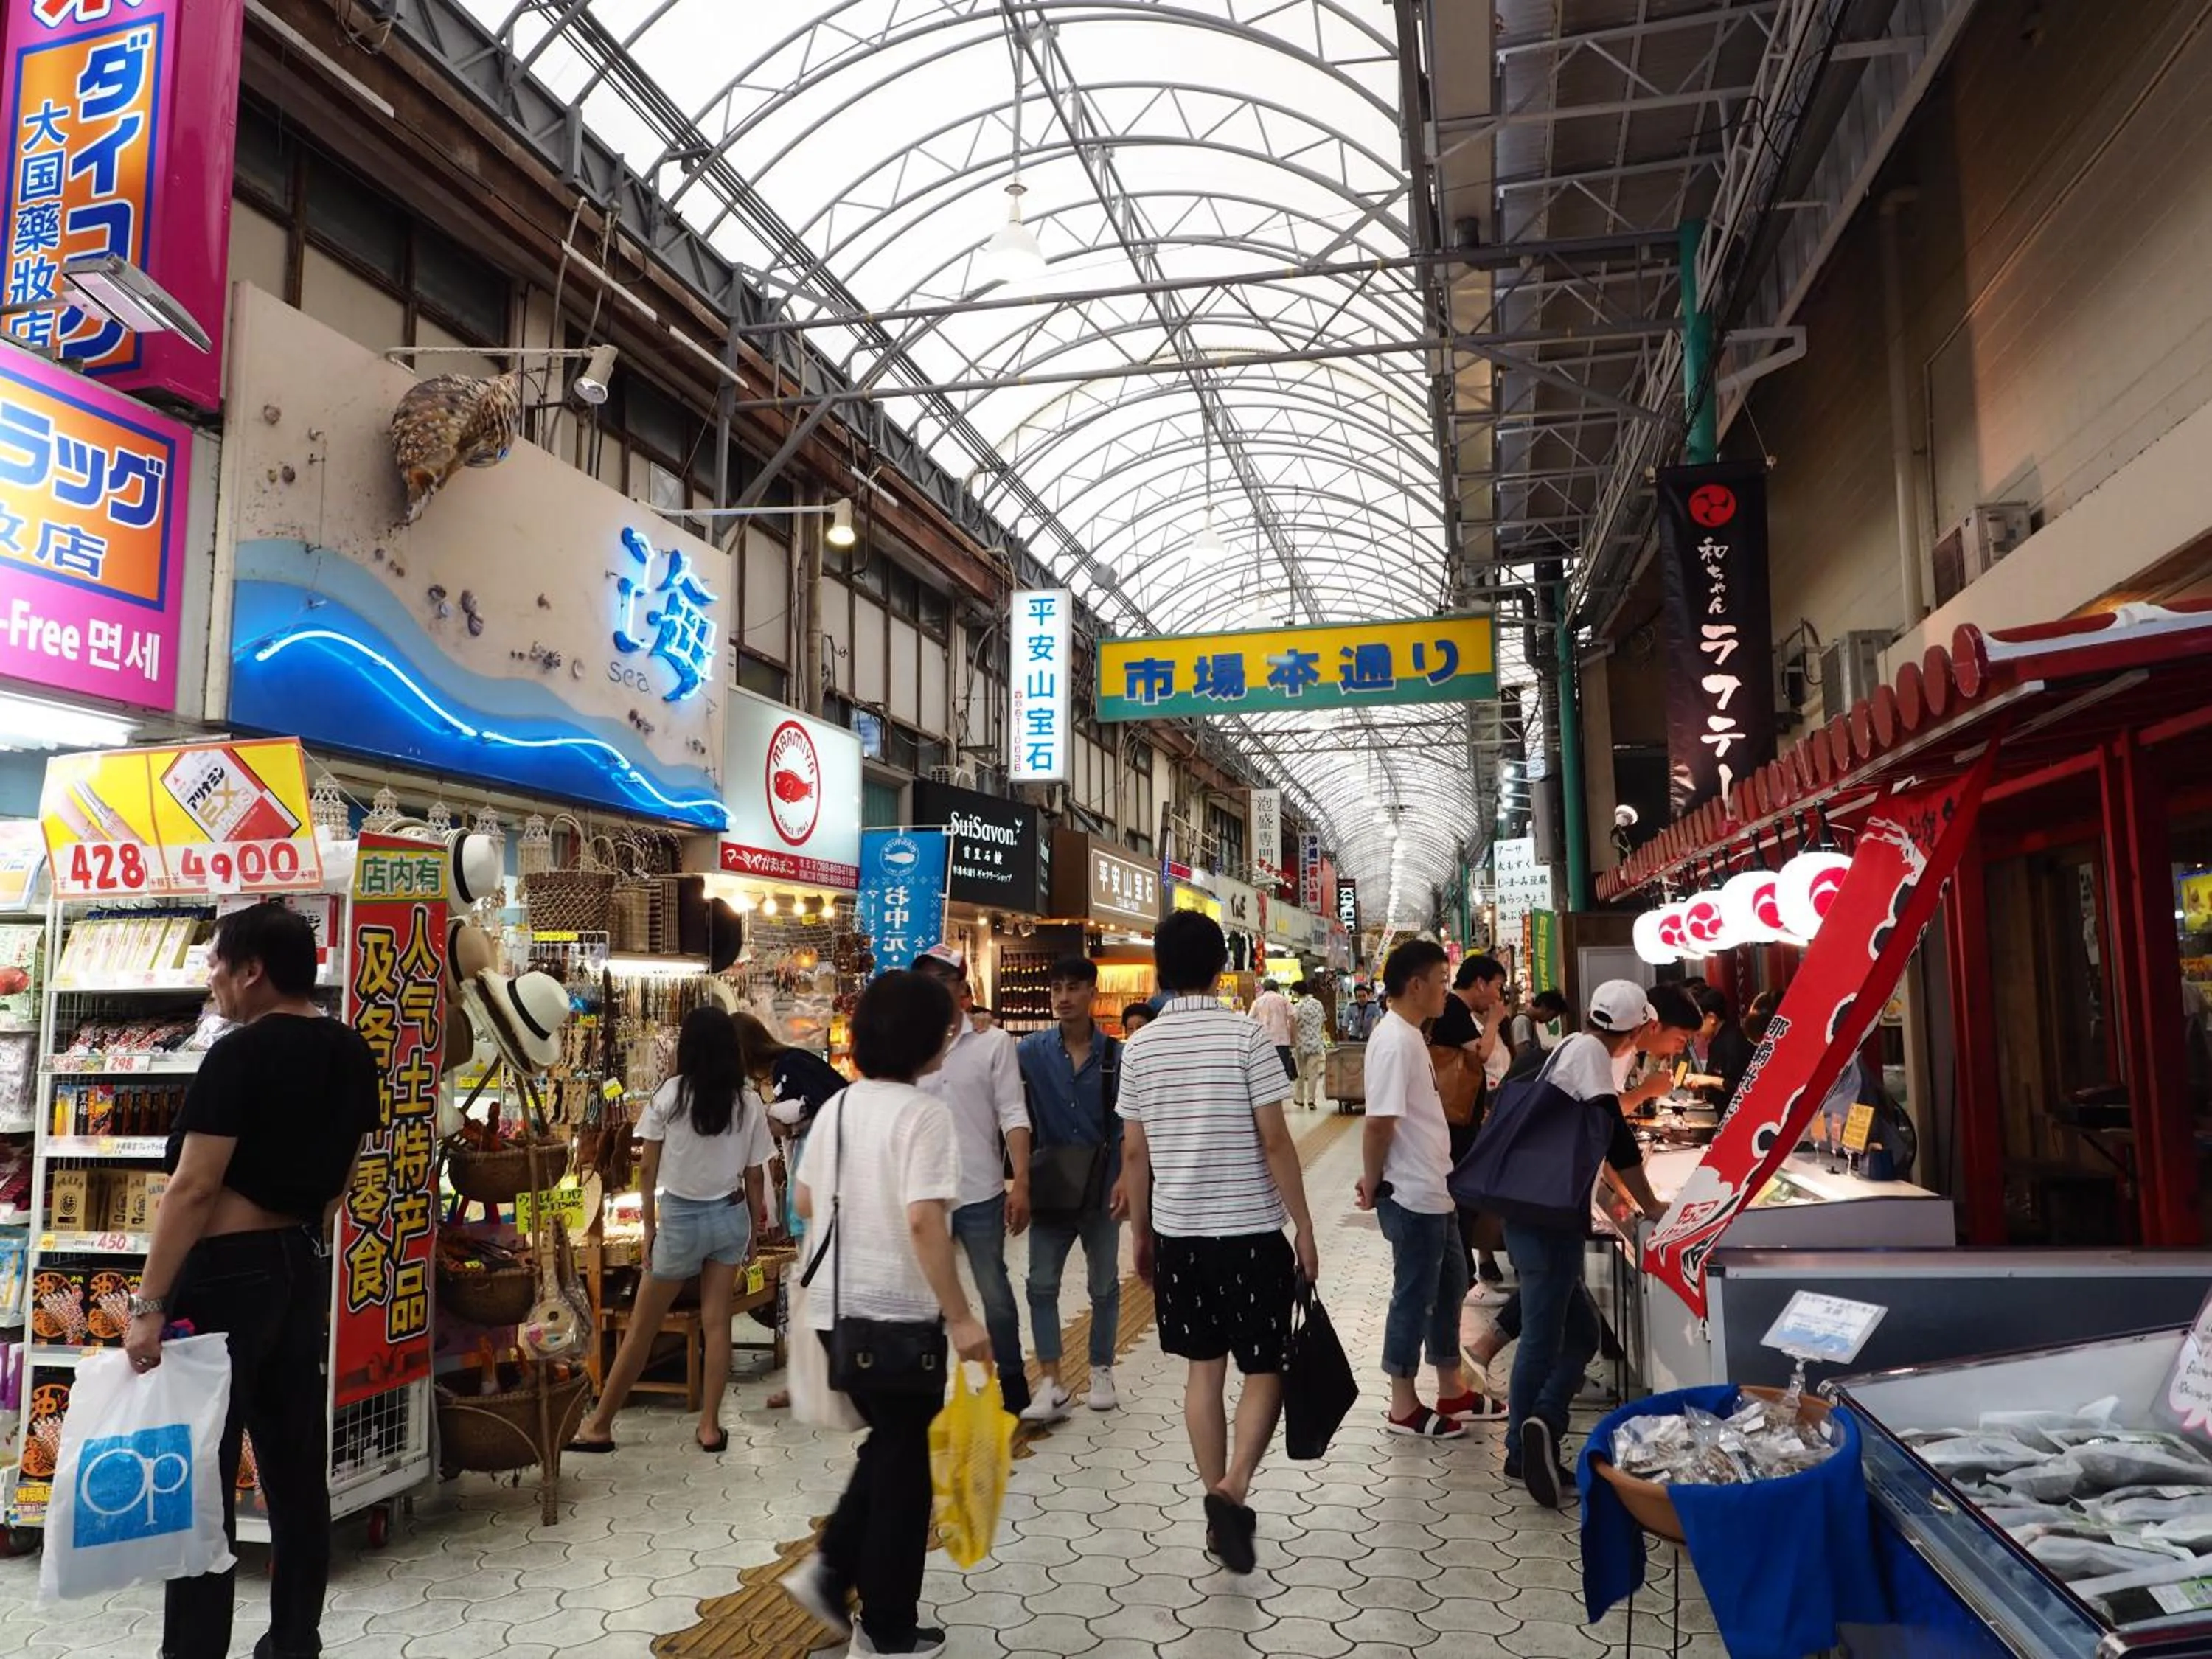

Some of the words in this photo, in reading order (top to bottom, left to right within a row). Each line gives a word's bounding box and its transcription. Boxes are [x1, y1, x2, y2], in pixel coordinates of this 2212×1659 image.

[87, 618, 160, 681] 면세
[1124, 639, 1460, 703] 市場本通り
[1026, 598, 1055, 771] 平安山宝石
[187, 766, 226, 811] アリナミン
[71, 843, 145, 889] 428
[181, 841, 299, 886] 4900
[361, 858, 442, 894] 店内有
[111, 1057, 134, 1070] 298
[389, 908, 439, 1335] 人气土特产品
[97, 1234, 127, 1250] 450
